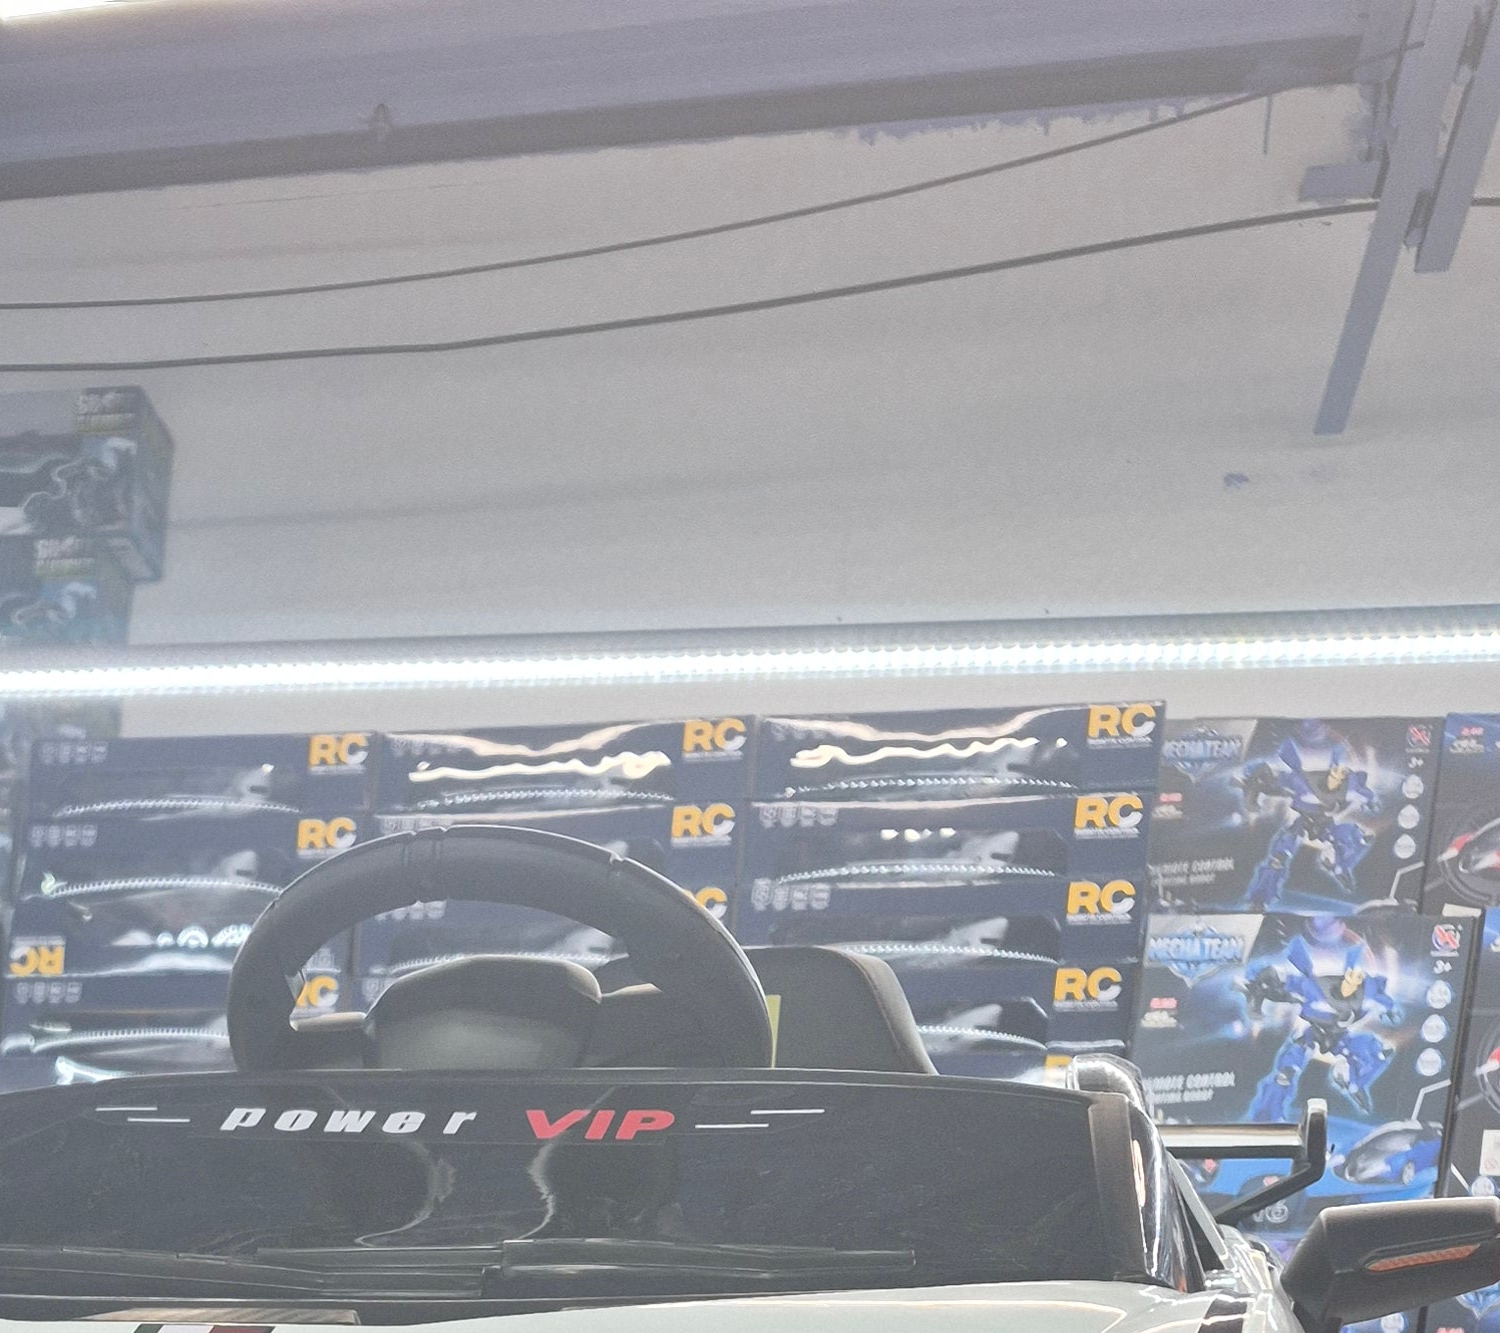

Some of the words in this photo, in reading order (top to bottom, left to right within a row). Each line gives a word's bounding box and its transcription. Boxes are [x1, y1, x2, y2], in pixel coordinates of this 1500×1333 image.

[683, 718, 747, 754] RC
[1087, 703, 1156, 737] RC
[309, 734, 369, 767] RC
[671, 803, 735, 840] RC
[1074, 794, 1143, 829] RC
[297, 817, 357, 851] RC
[1067, 879, 1136, 917] RC
[298, 976, 339, 1006] C
[1054, 967, 1122, 1003] RC
[525, 1109, 675, 1140] VIP
